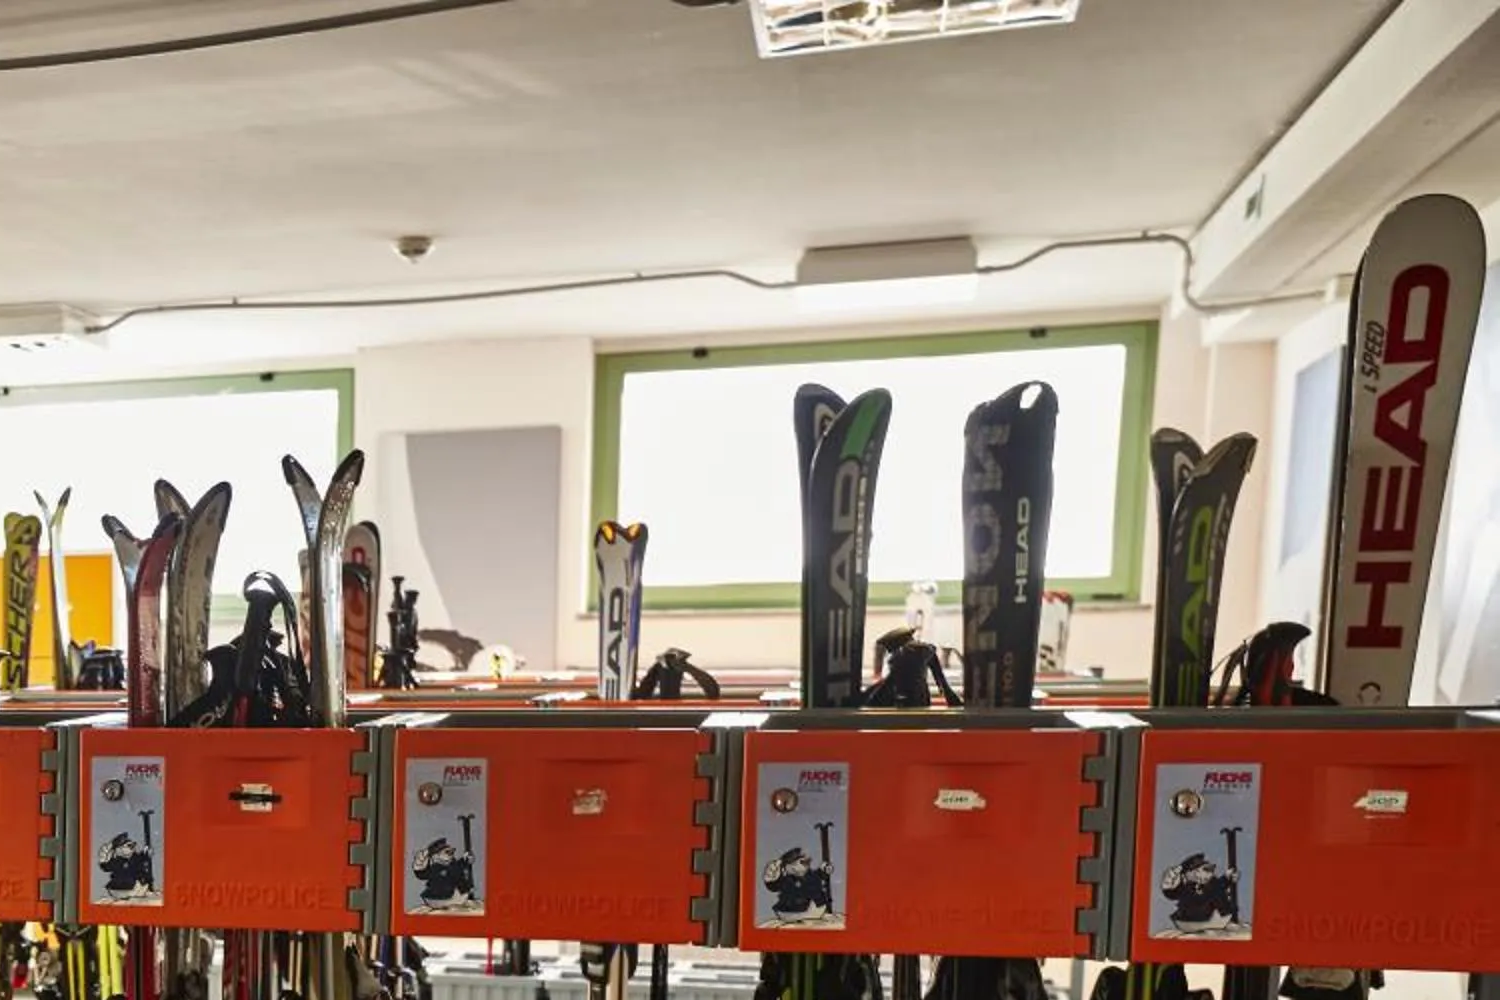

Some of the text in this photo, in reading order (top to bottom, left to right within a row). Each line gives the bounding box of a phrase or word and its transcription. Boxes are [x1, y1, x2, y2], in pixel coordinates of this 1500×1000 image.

[1360, 320, 1386, 380] SPEED
[1346, 263, 1450, 649] HEAD
[1013, 496, 1030, 604] HEAD
[3, 551, 31, 691] SCHER
[604, 586, 625, 700] EAD
[1176, 506, 1214, 705] EAD
[444, 765, 482, 775] FUCHS
[801, 770, 842, 781] FUCHS
[1203, 771, 1253, 784] FUCHS
